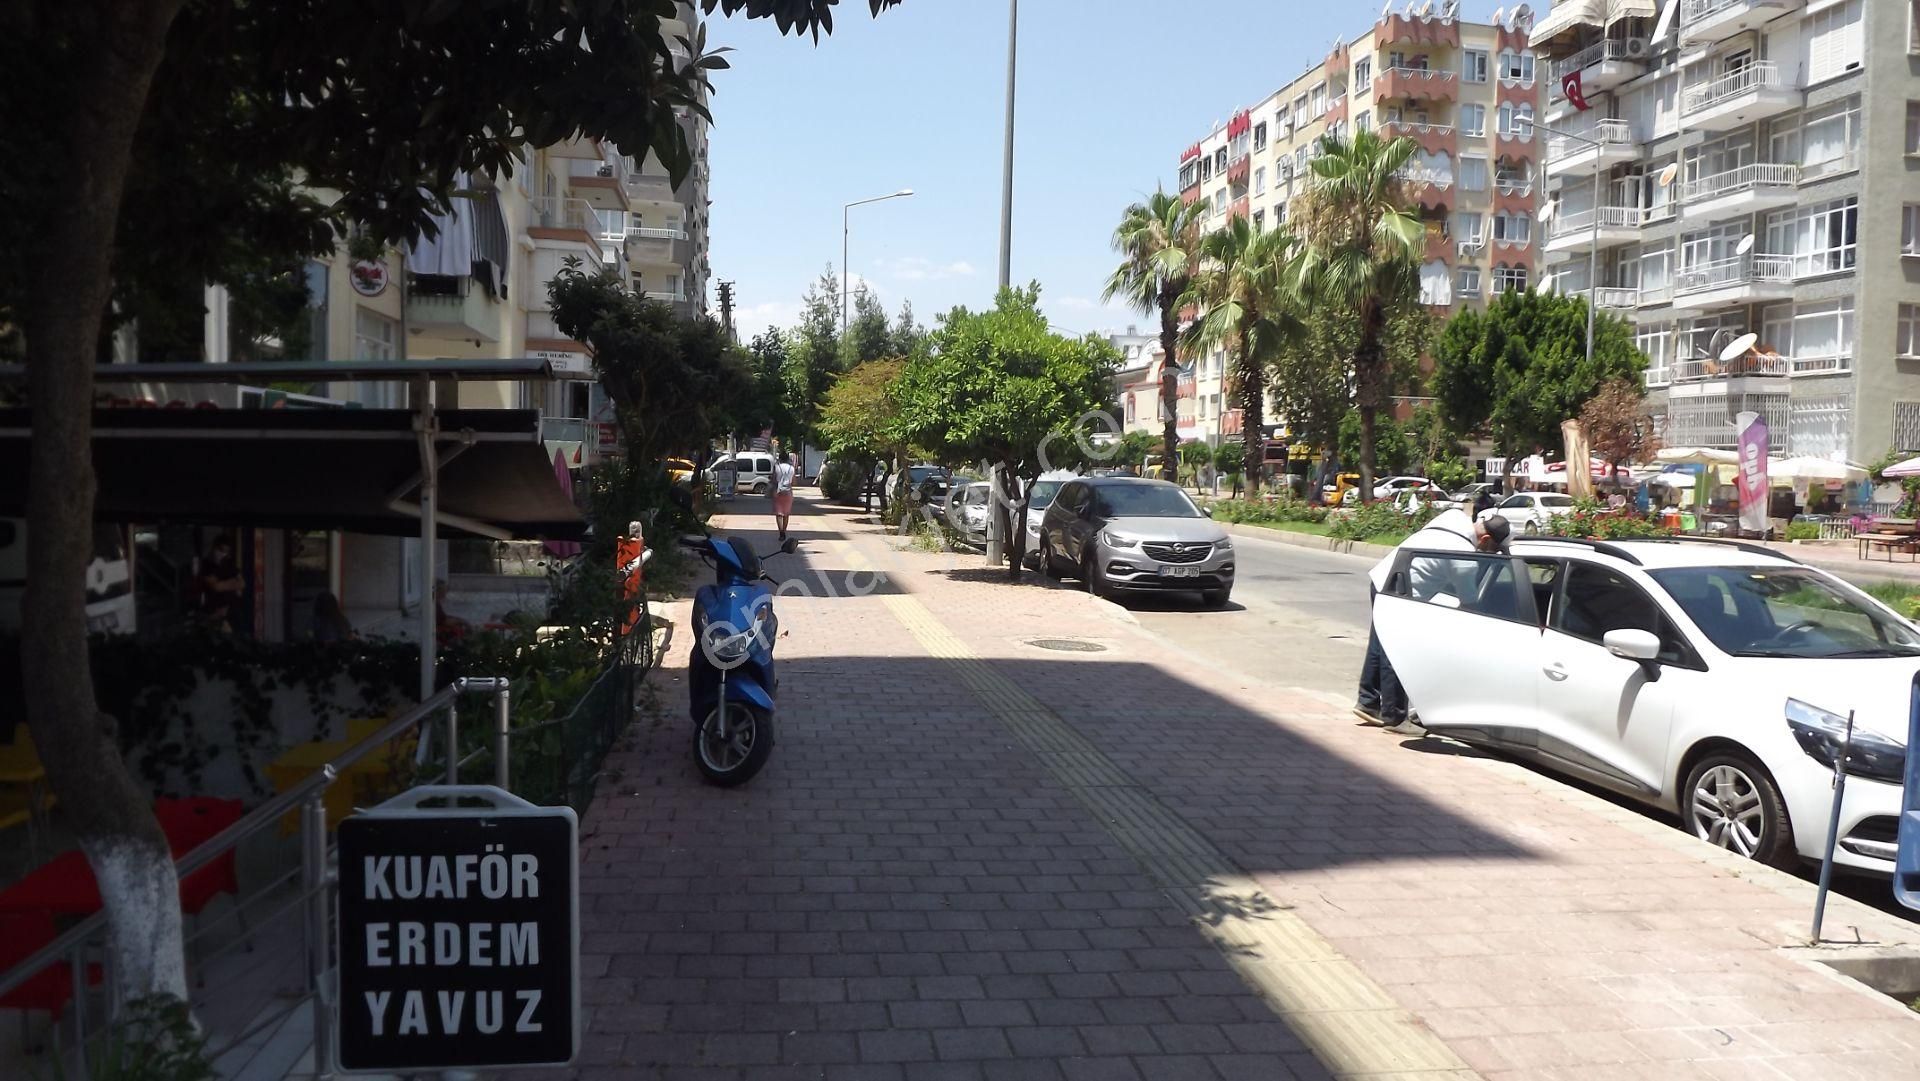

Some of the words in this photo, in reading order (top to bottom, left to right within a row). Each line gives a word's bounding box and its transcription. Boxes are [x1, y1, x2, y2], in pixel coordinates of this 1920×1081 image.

[364, 844, 540, 900] KUAFÖR
[365, 921, 540, 967] ERDEM
[364, 989, 543, 1036] YAVUZ
